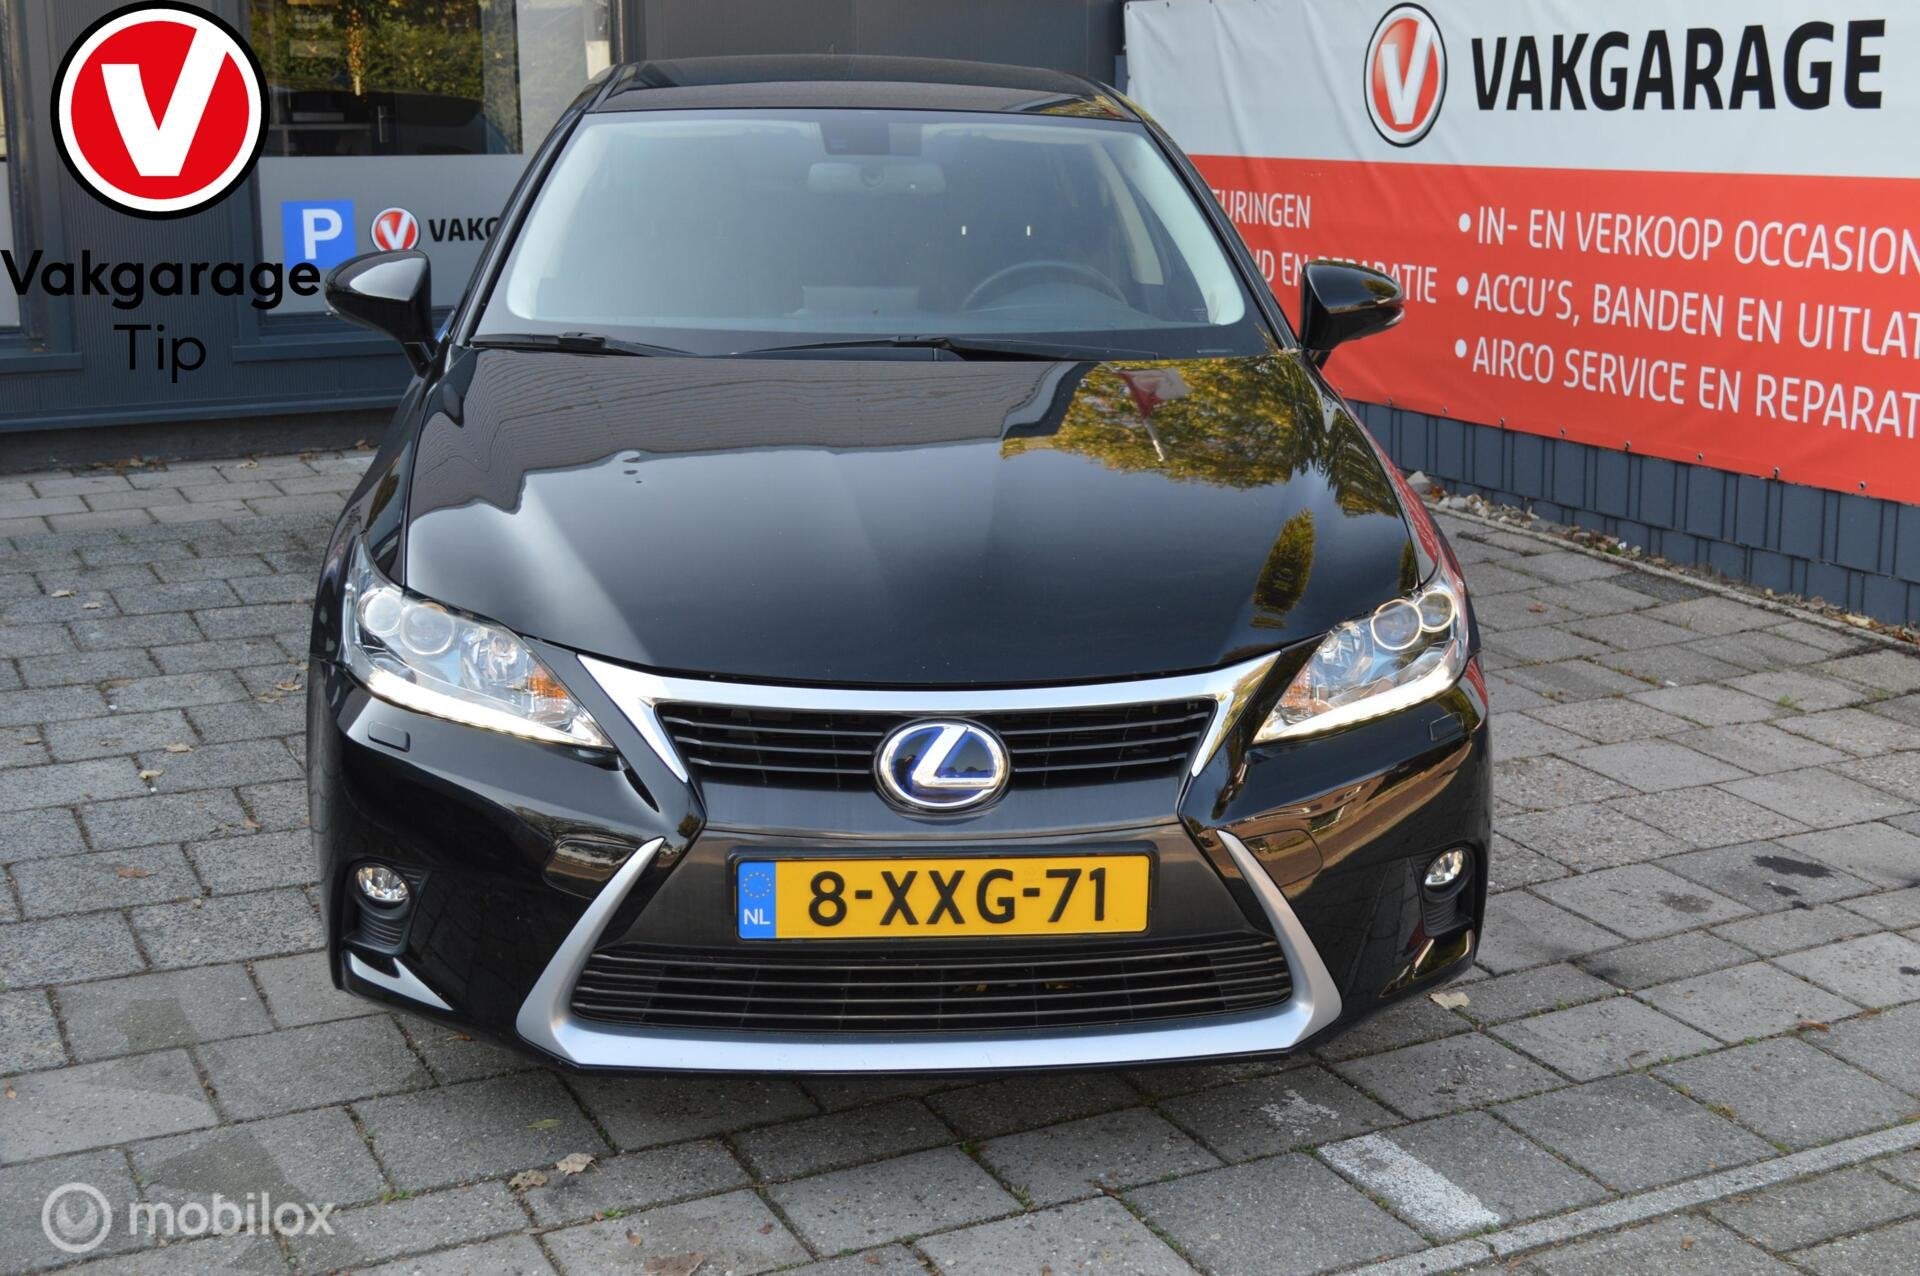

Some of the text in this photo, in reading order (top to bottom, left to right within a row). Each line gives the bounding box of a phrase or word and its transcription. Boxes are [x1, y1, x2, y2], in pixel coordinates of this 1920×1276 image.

[1471, 20, 1886, 111] VAKGARAGE
[302, 208, 343, 260] P
[1211, 189, 1311, 229] URINGEN
[1478, 206, 1920, 276] IN- EN VERKOOP OCCASION
[1474, 272, 1580, 327] ACCU'S,
[1593, 283, 1724, 337] BANDEN
[1737, 297, 1783, 344] EN
[1473, 336, 1920, 439] AIRCO SERVICE EN REPARAT
[743, 908, 771, 926] NL
[808, 867, 1107, 927] 8-XXG-71
